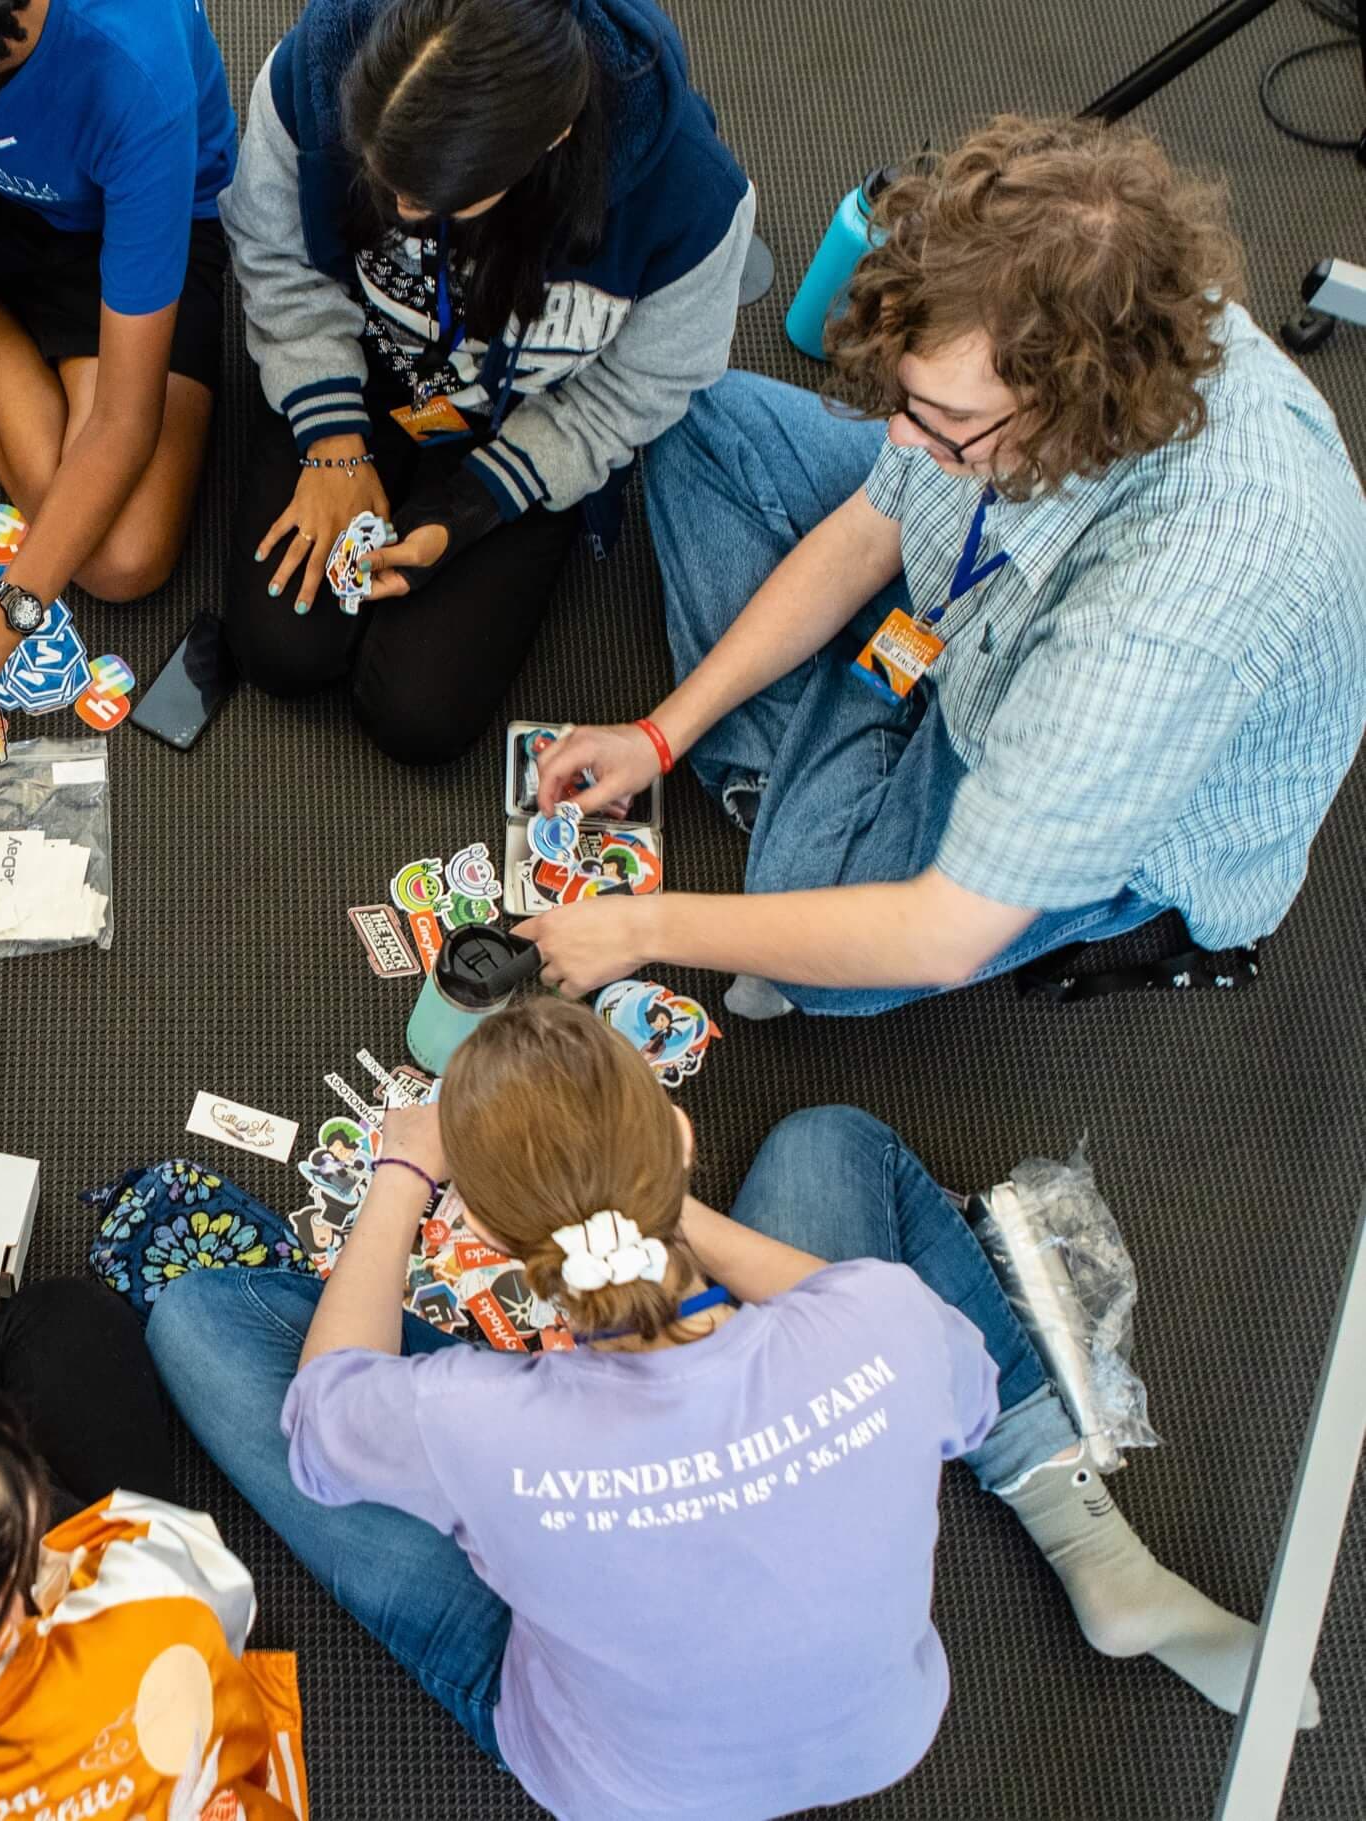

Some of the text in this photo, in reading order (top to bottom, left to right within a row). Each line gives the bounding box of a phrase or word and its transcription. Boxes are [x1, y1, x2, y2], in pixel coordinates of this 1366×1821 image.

[369, 910, 408, 970] THE HACK
[511, 1354, 897, 1500] LAVENDER HILL FARM
